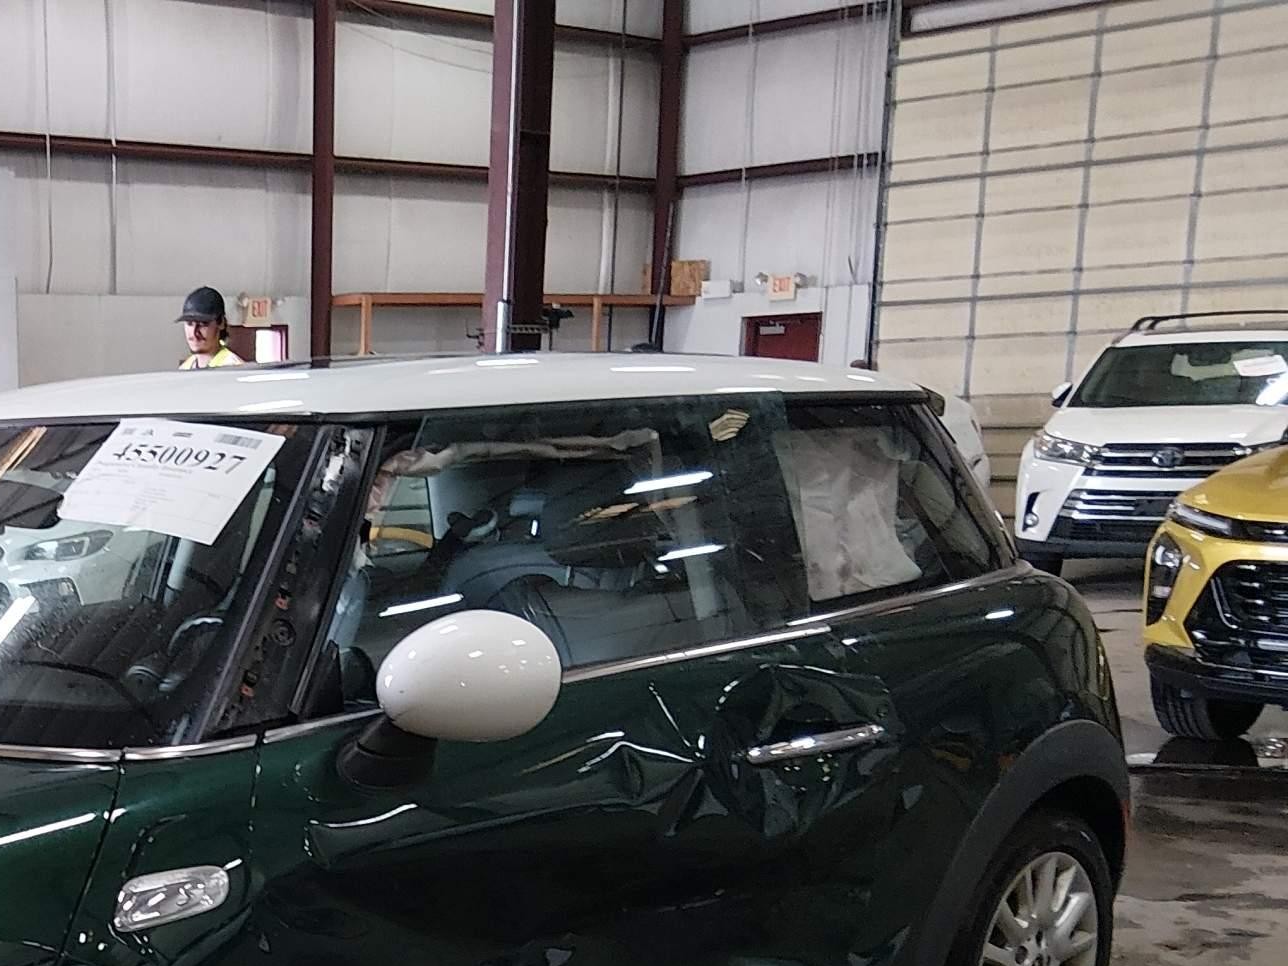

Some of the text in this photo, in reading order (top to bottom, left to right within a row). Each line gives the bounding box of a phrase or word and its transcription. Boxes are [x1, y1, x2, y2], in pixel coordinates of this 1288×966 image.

[772, 276, 791, 293] EXIT
[252, 299, 269, 318] EXIT
[113, 443, 247, 475] 45500927
